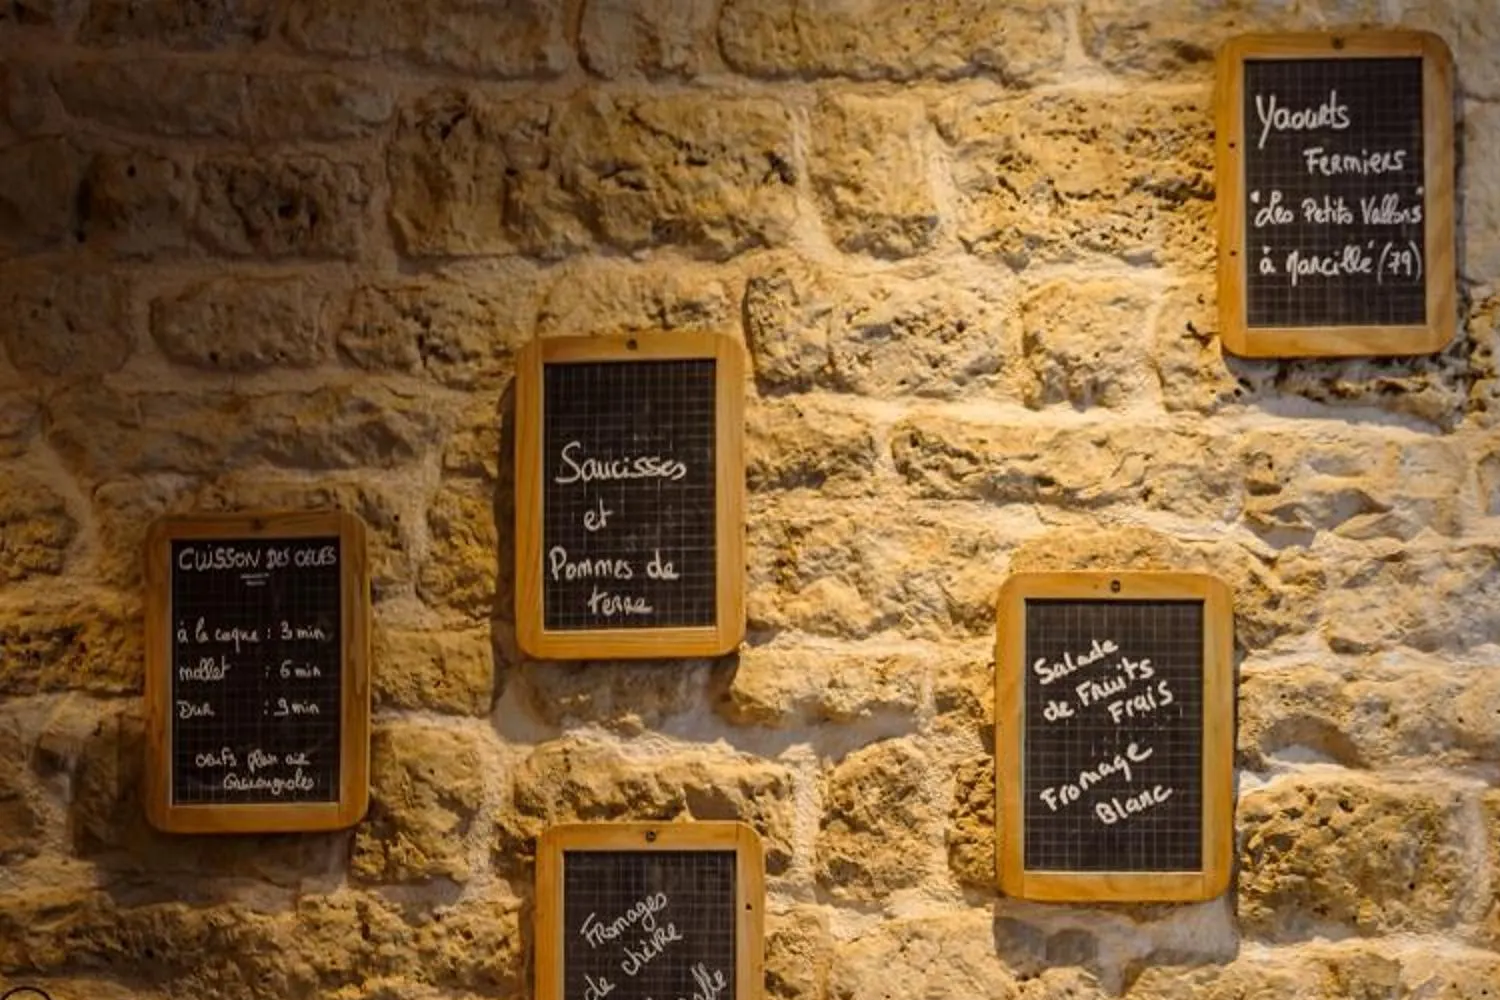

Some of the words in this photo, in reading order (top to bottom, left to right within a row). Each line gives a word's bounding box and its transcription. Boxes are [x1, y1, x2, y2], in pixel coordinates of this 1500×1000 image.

[1255, 90, 1350, 149] Yaourts
[1303, 147, 1407, 176] Fermiers
[1301, 194, 1353, 225] Petits
[1259, 245, 1277, 275] à
[555, 441, 688, 483] Saucisses
[583, 499, 614, 531] et
[178, 545, 261, 572] CUISSON
[550, 545, 633, 581] Pommes
[646, 549, 681, 581] de
[587, 586, 653, 616] terre
[177, 619, 189, 644] à
[195, 616, 209, 643] la
[215, 627, 259, 654] coque
[279, 619, 293, 640] 3
[296, 623, 326, 641] min
[178, 655, 233, 682] mollet
[279, 659, 294, 678] 6
[294, 662, 322, 678] min
[1033, 639, 1119, 685] Salade
[291, 699, 321, 716] min
[1043, 699, 1075, 722] de
[1074, 655, 1156, 707] Fruits
[1107, 679, 1174, 724] Frais
[1038, 741, 1154, 812] Fromage
[1094, 783, 1174, 825] Blanc
[579, 890, 667, 949] Fromages
[621, 922, 683, 977] chèvre
